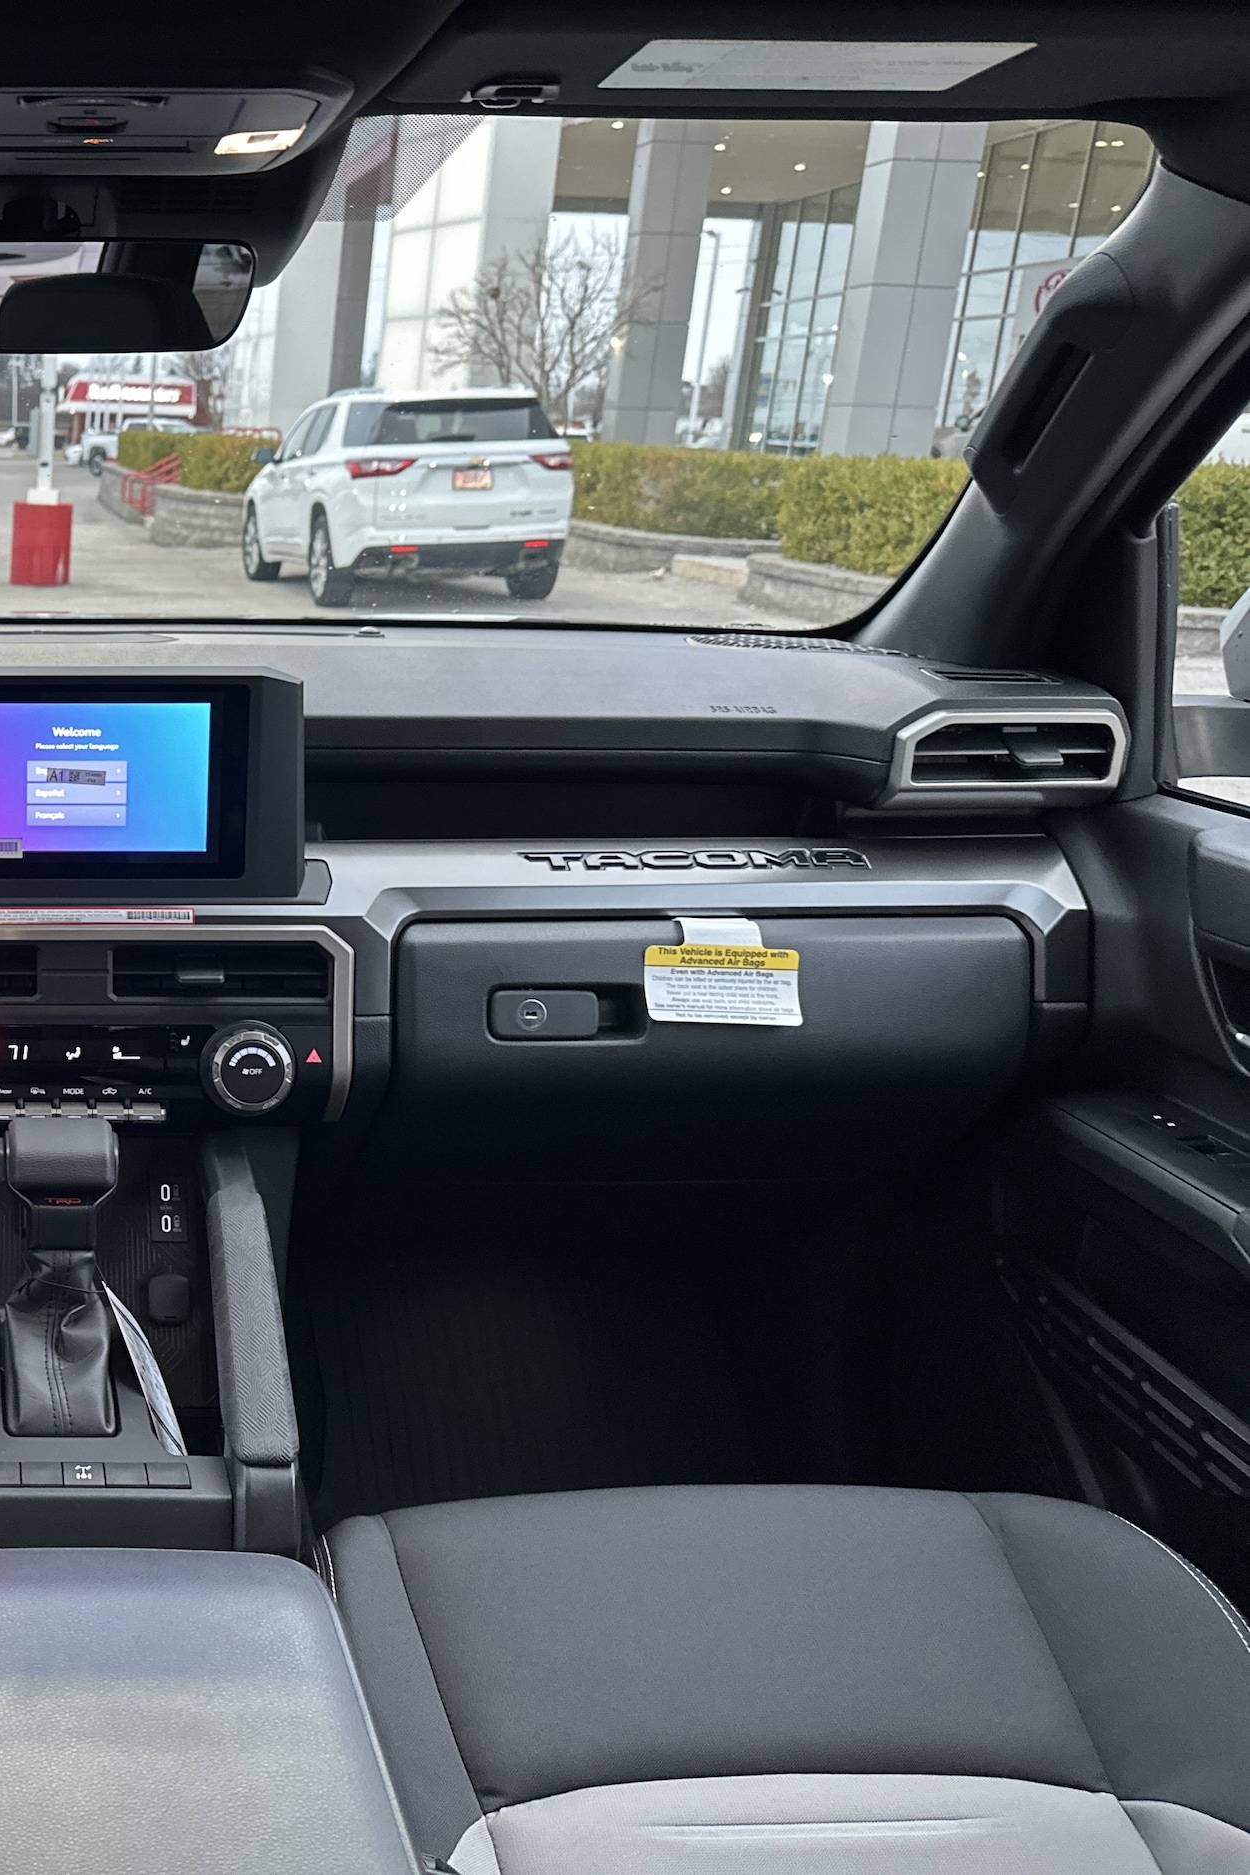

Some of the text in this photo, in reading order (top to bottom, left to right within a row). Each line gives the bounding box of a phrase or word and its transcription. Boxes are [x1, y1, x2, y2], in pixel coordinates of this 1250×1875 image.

[733, 706, 777, 714] AIRBAG
[52, 727, 102, 737] Welcome
[50, 770, 64, 781] A1
[35, 789, 65, 798] Español
[35, 812, 65, 820] Français
[512, 848, 872, 872] TACOMA
[680, 948, 712, 956] Vehicle
[725, 949, 768, 959] Equipped
[680, 957, 725, 965] Advanced
[742, 959, 766, 968] Bags
[8, 1044, 28, 1060] 71
